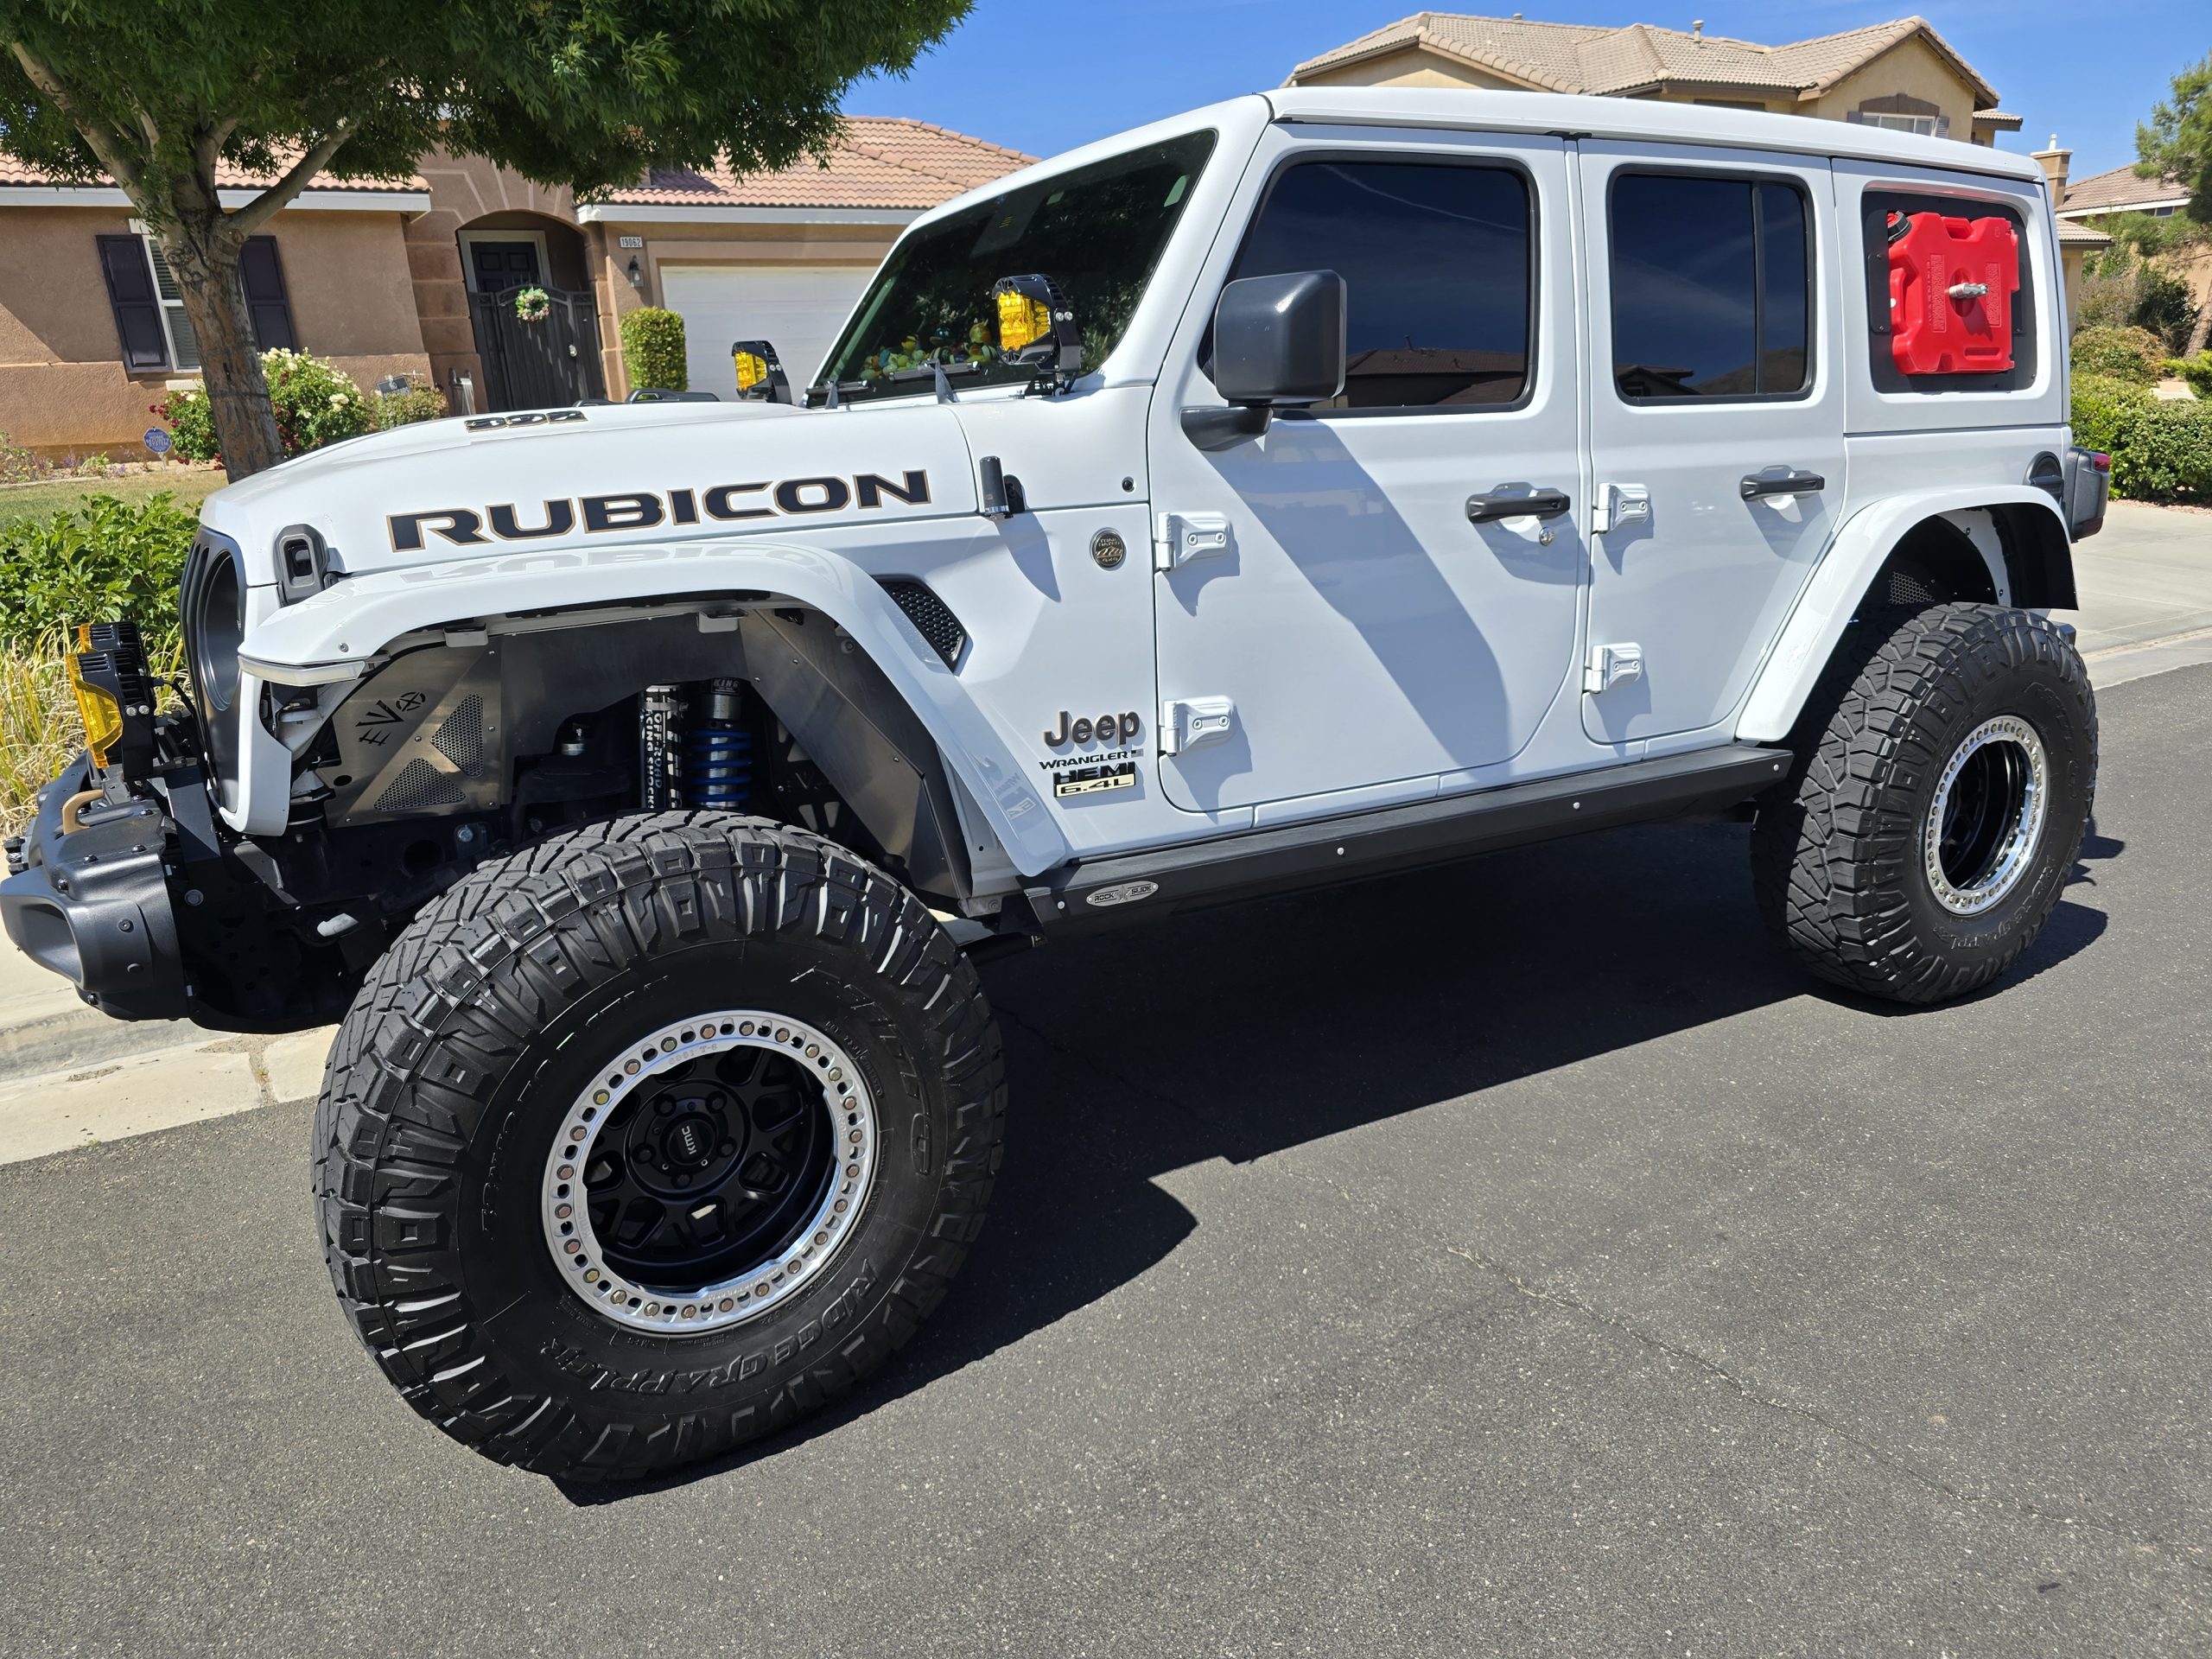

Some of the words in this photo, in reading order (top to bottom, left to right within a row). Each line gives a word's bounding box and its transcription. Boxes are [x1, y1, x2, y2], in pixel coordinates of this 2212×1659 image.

[385, 468, 932, 554] RUBICON
[713, 678, 740, 688] KING
[1043, 710, 1141, 747] Jeep
[653, 712, 663, 789] OFF-ROAD
[1039, 750, 1128, 770] WRANGLER
[1052, 761, 1136, 785] HEMI
[1060, 779, 1131, 794] 6.4L
[1094, 892, 1116, 902] ROCK
[681, 1125, 697, 1155] KMC
